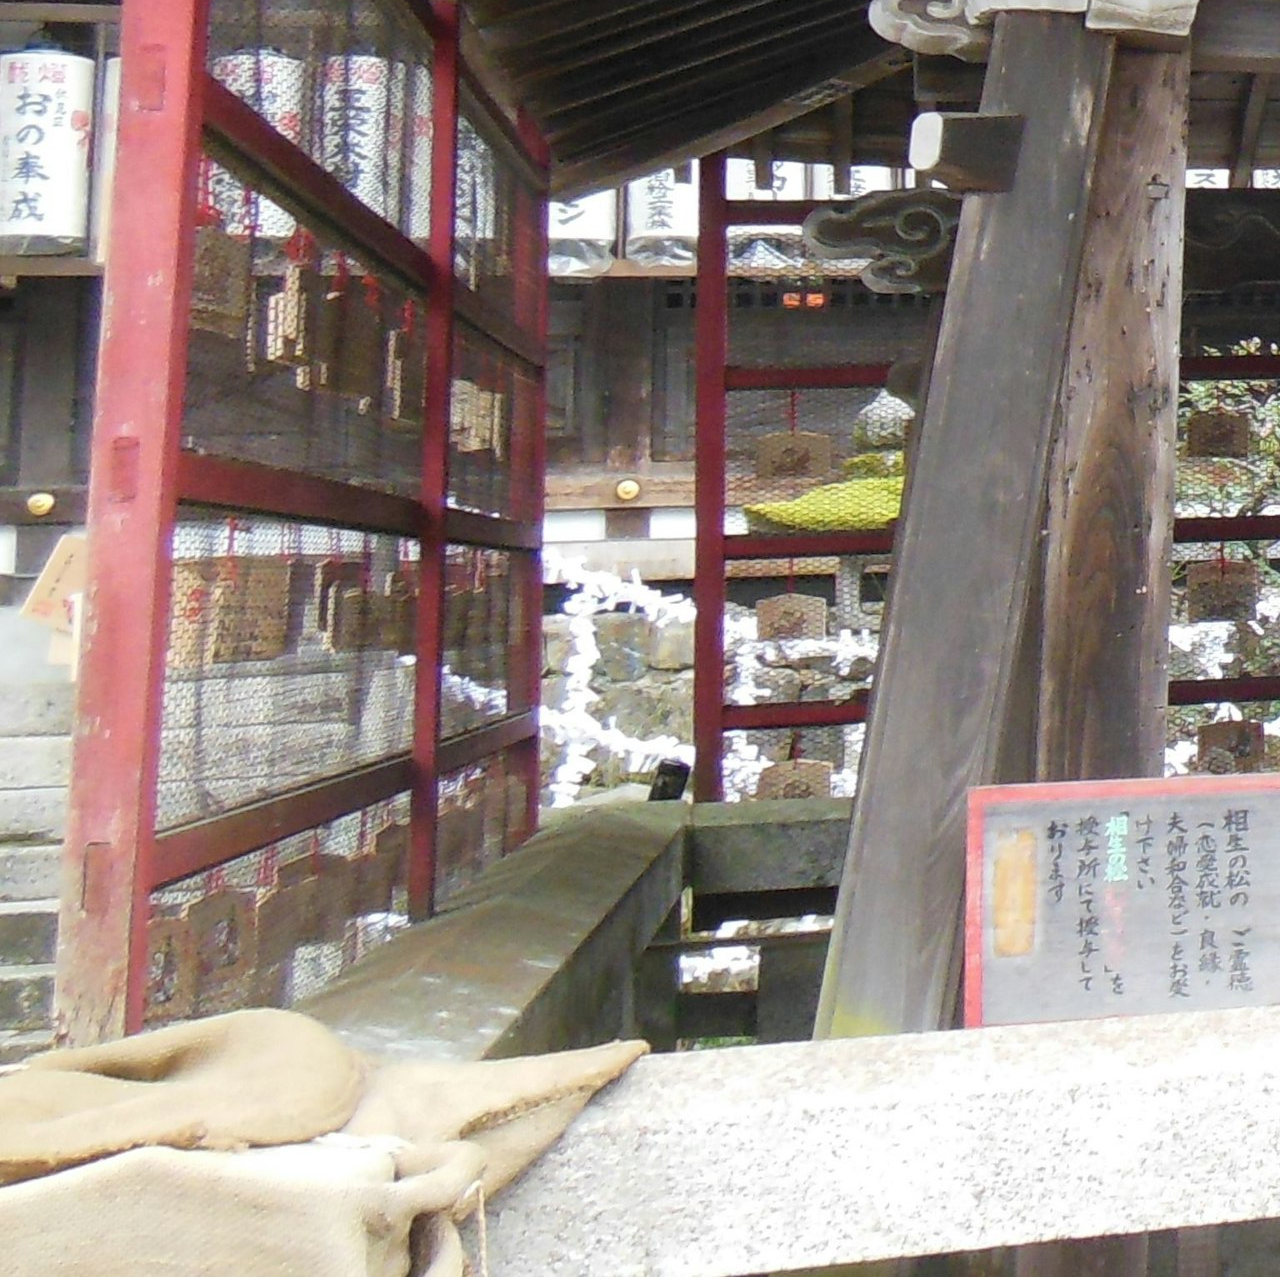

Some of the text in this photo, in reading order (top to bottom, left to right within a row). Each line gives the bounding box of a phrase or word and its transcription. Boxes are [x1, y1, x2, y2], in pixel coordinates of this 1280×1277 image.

[1046, 819, 1068, 904] おります
[1134, 812, 1156, 890] け下さい
[1075, 816, 1101, 991] 授与所にて授与して
